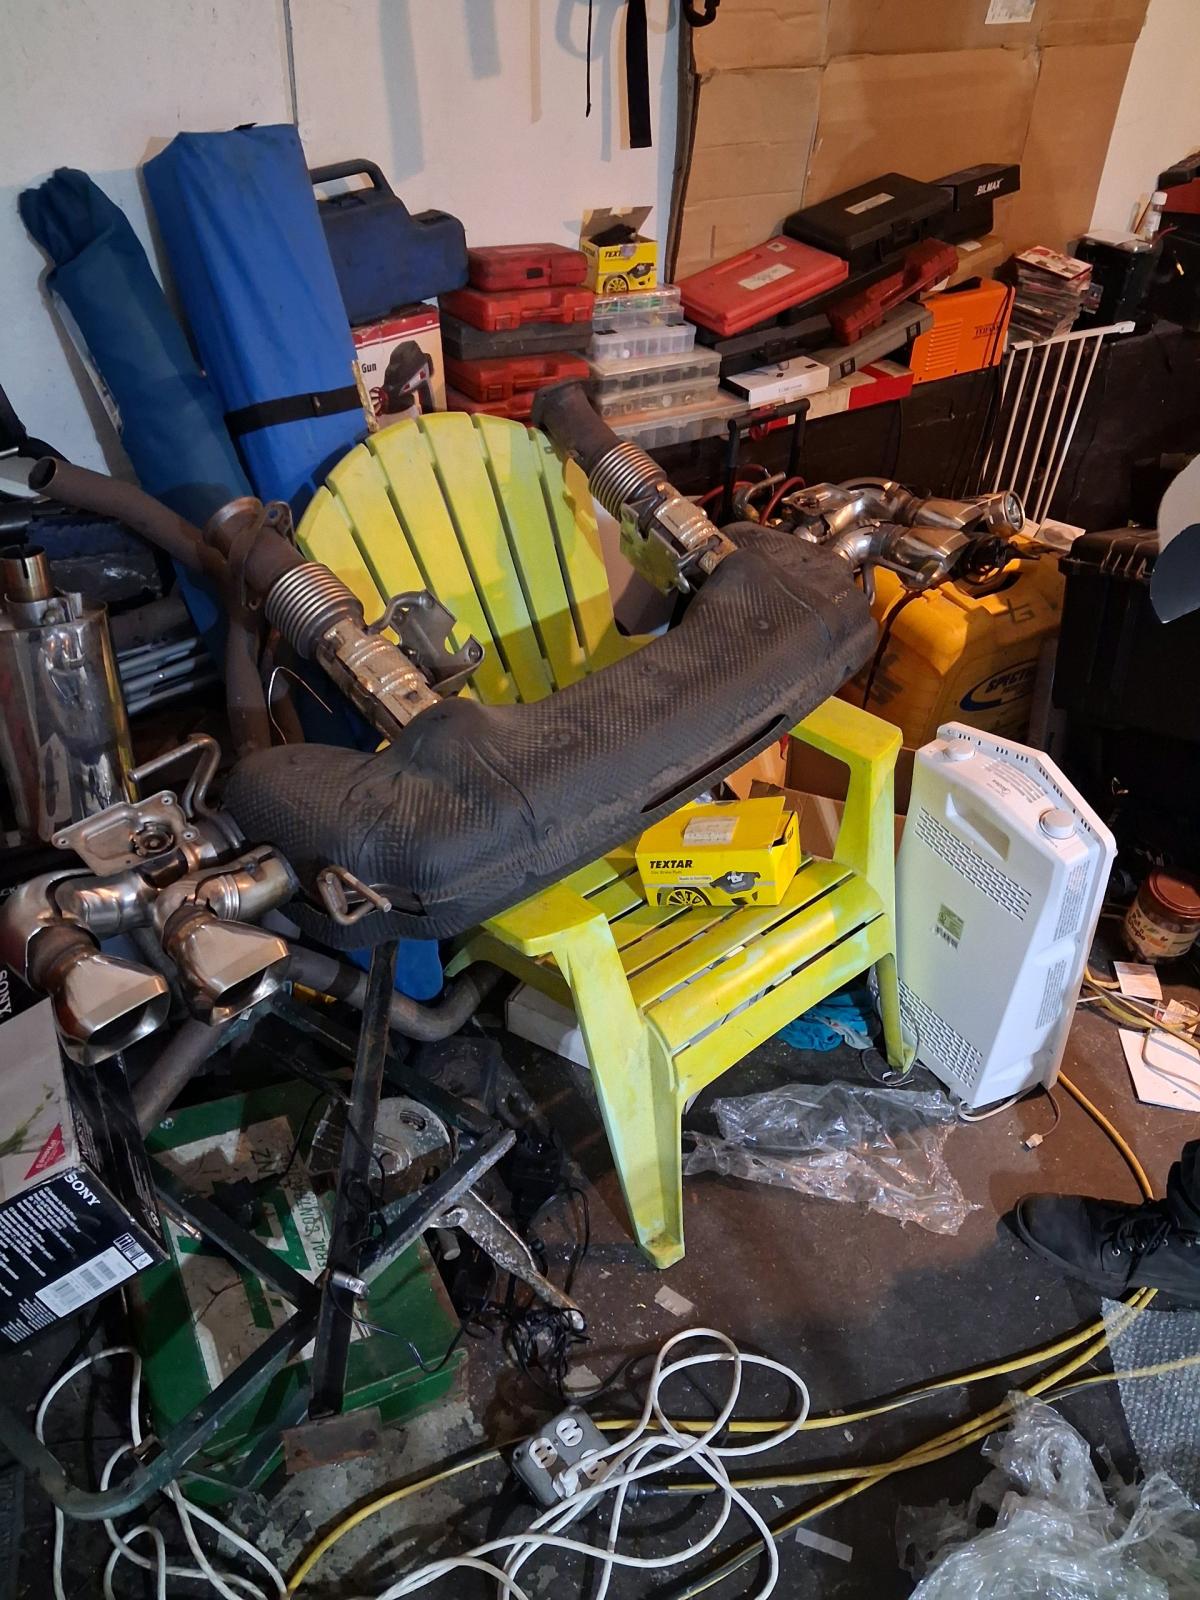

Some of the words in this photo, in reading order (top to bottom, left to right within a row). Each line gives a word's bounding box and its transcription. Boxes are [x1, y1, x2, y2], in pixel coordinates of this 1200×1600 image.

[361, 363, 377, 373] Gun
[650, 859, 692, 869] TEXTAR
[64, 1172, 101, 1206] SONY
